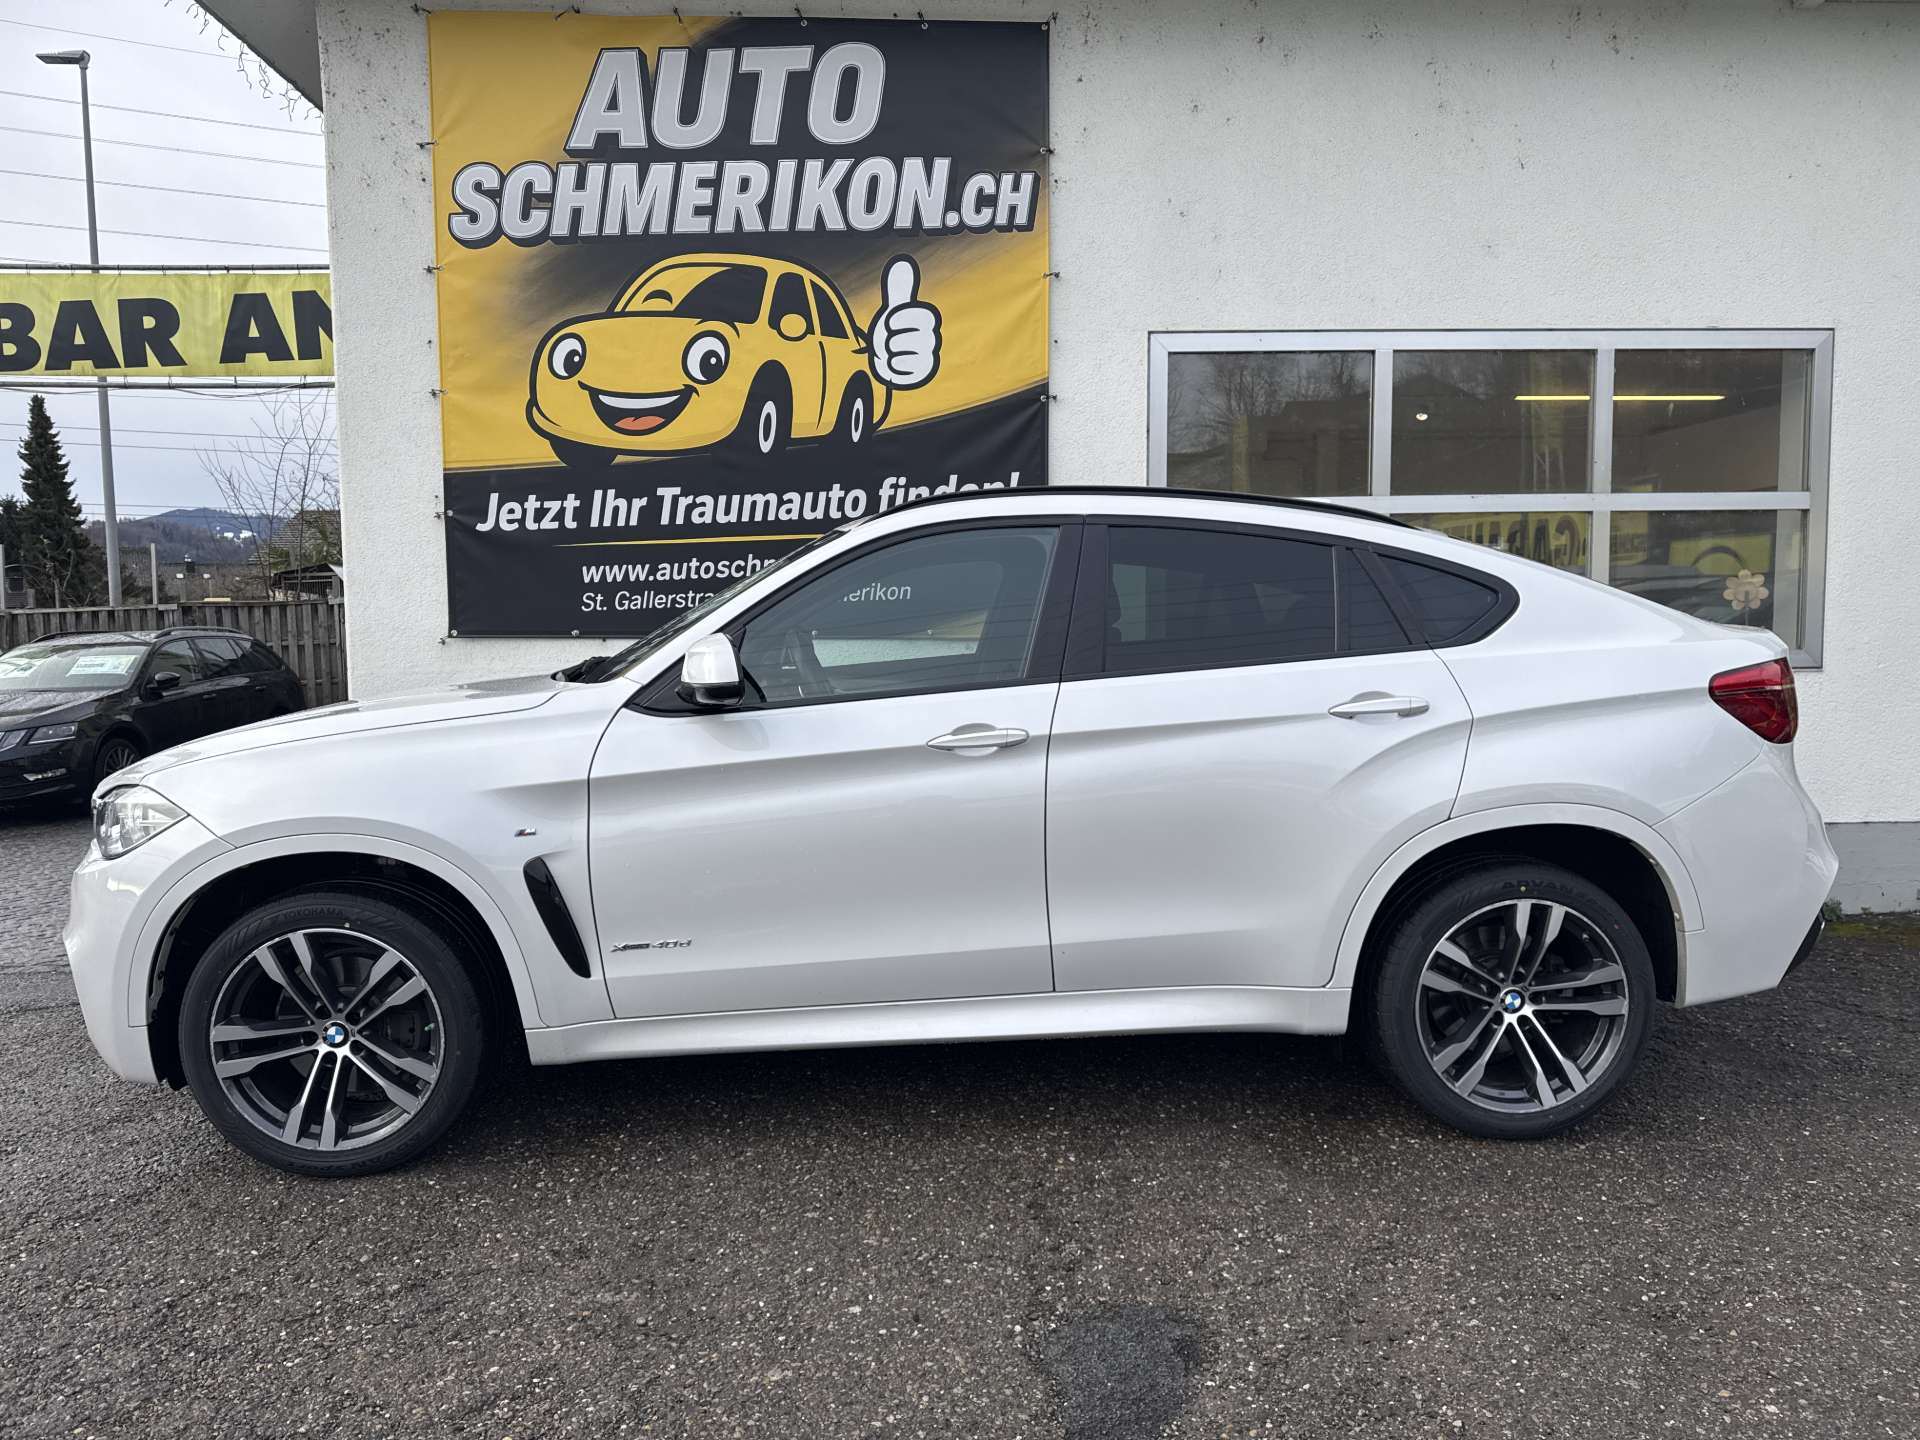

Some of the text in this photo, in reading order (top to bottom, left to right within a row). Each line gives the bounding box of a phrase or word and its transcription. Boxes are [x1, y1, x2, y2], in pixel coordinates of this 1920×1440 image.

[564, 42, 886, 150] AUTO
[449, 156, 1035, 240] SCHMERIKON.CH
[0, 297, 188, 372] BAR
[475, 491, 581, 532] Jetzt
[589, 488, 648, 528] Ihr
[656, 483, 868, 525] Traumauto
[581, 592, 607, 612] St.
[843, 582, 912, 602] erikon
